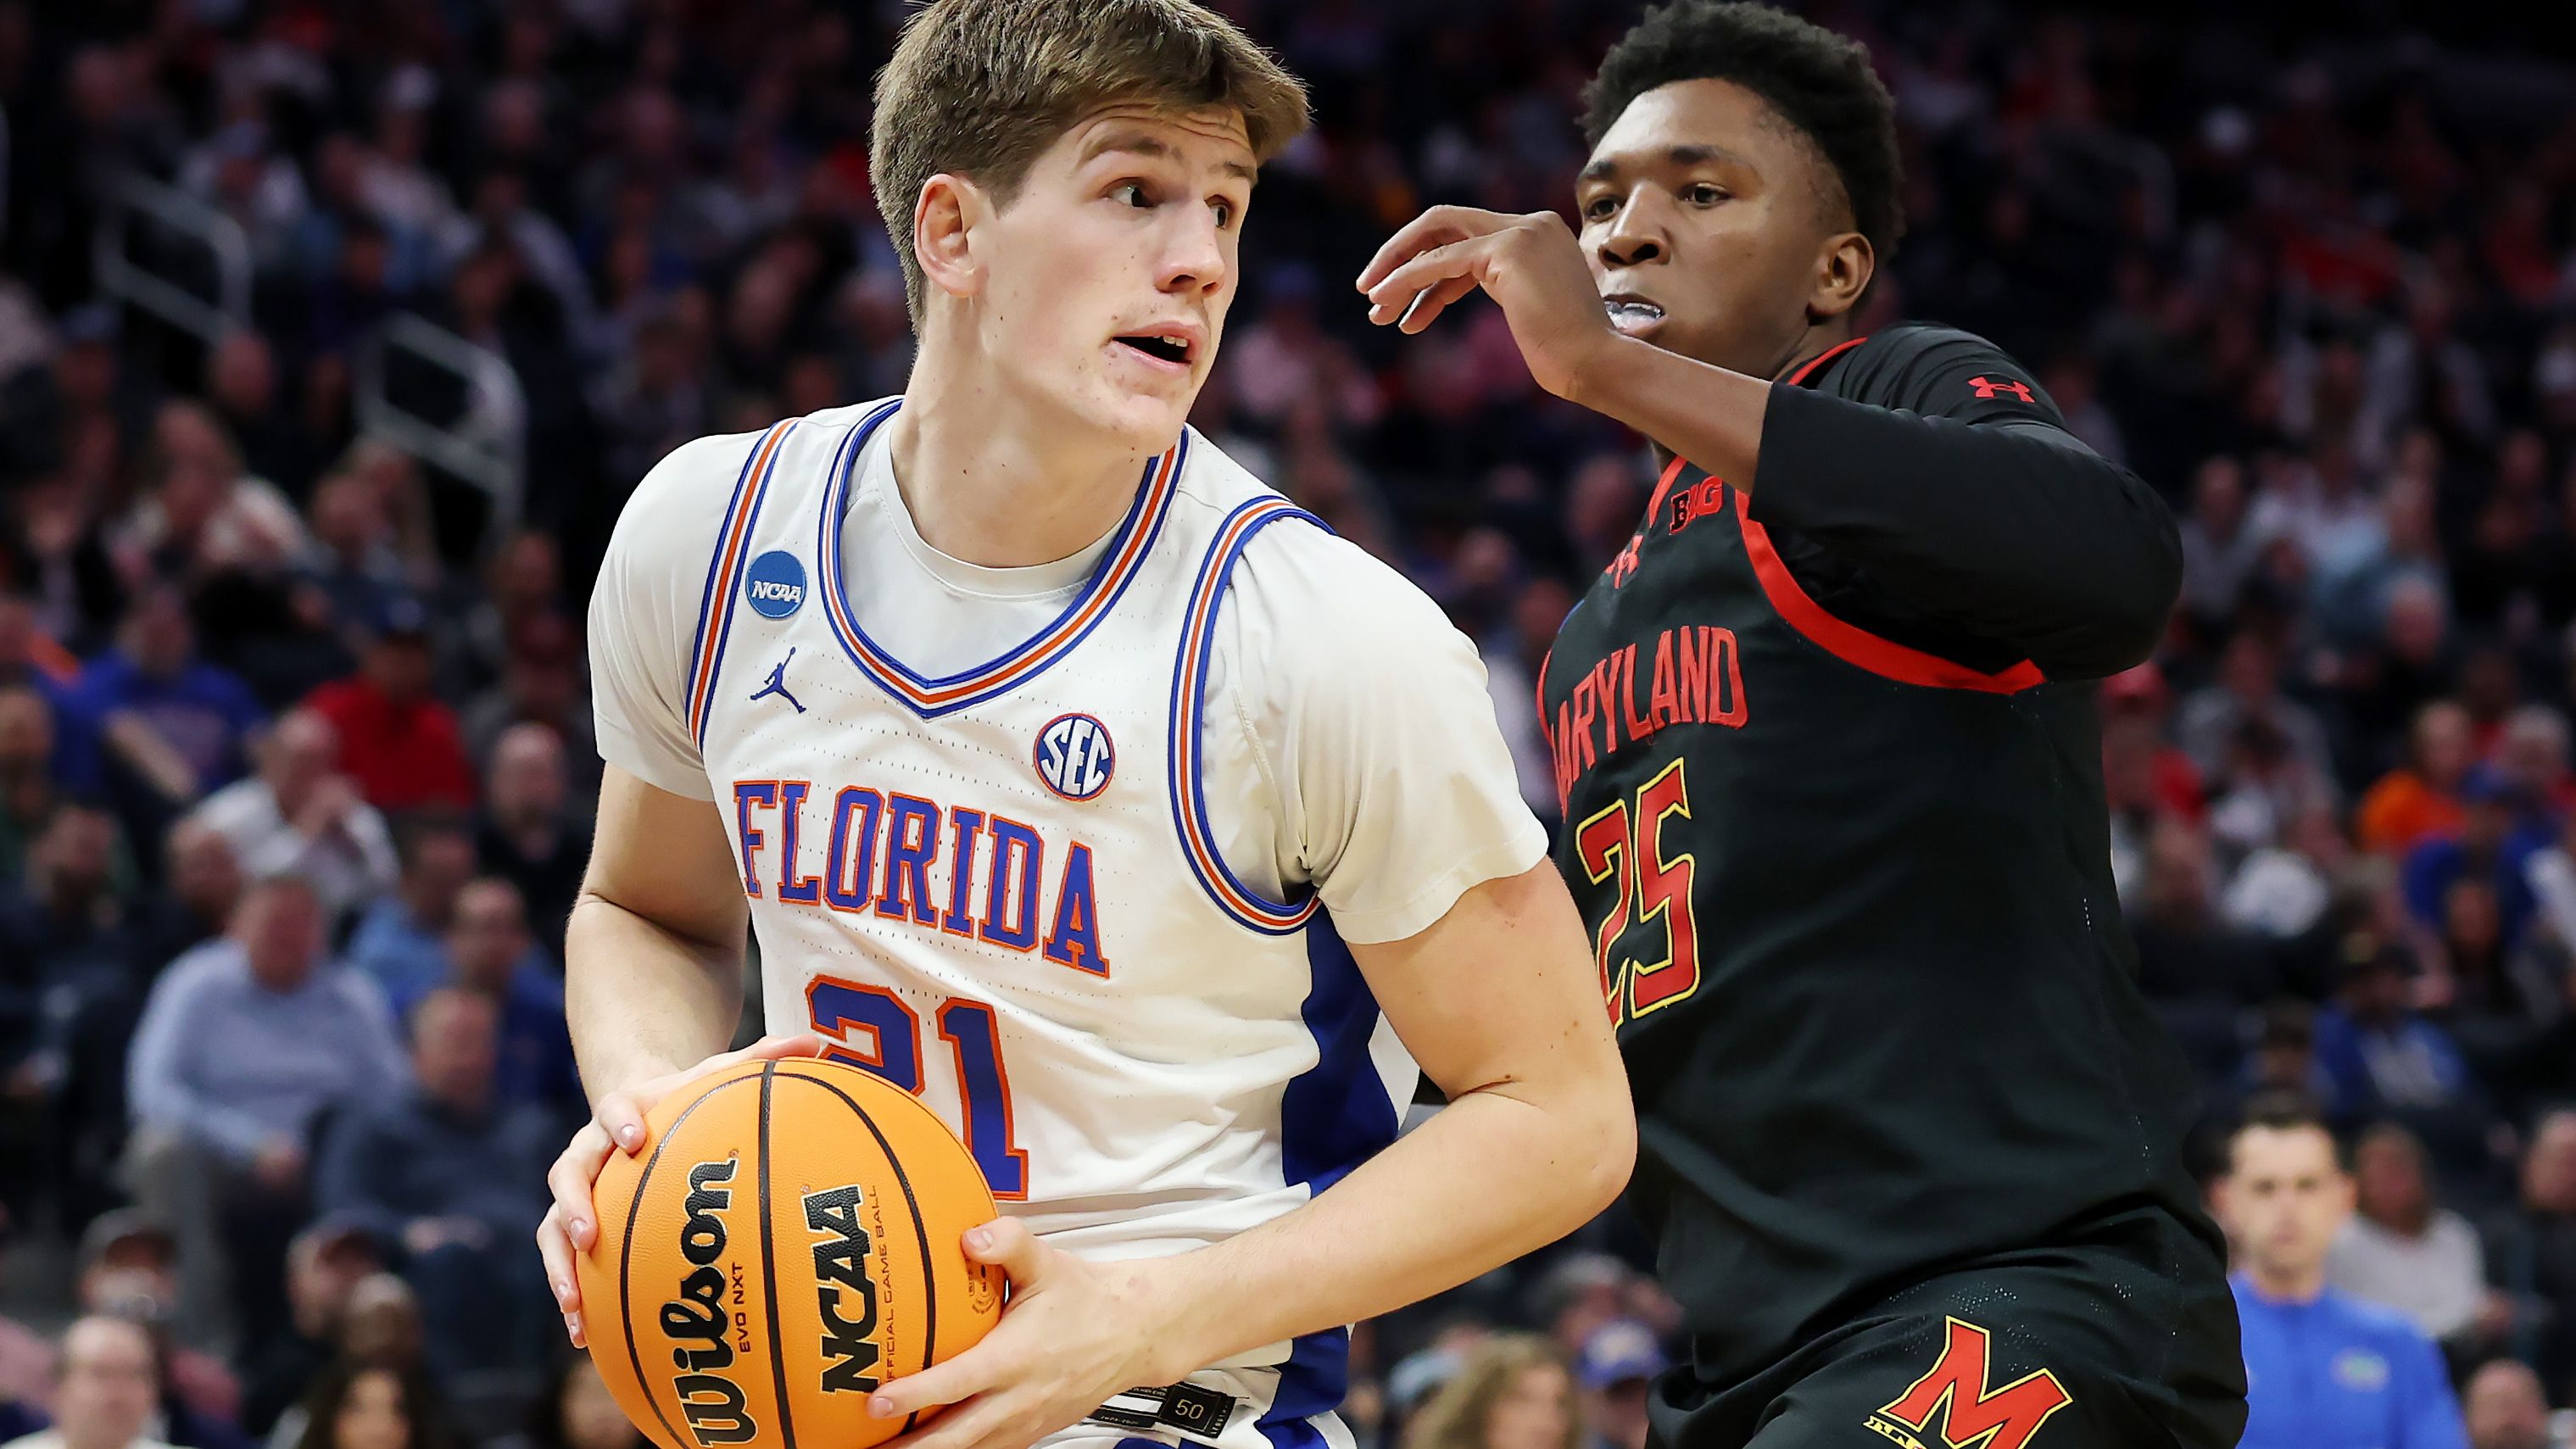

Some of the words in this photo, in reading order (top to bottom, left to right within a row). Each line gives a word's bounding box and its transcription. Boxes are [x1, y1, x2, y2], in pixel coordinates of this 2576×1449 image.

[751, 580, 801, 603] NCAA
[1040, 718, 1110, 795] SEC
[733, 779, 1110, 979] FLORIDA
[1575, 756, 1700, 1034] 25
[805, 974, 1029, 1201] 21
[869, 1185, 885, 1238] BALL
[660, 1156, 758, 1448] Wilson
[731, 1262, 748, 1306] NXT
[801, 1184, 881, 1395] NCAA
[877, 1245, 893, 1304] GAME
[733, 1312, 751, 1354] EVO
[885, 1308, 896, 1385] FFICIAL
[1174, 1398, 1205, 1420] 50
[1876, 1315, 2074, 1449] M
